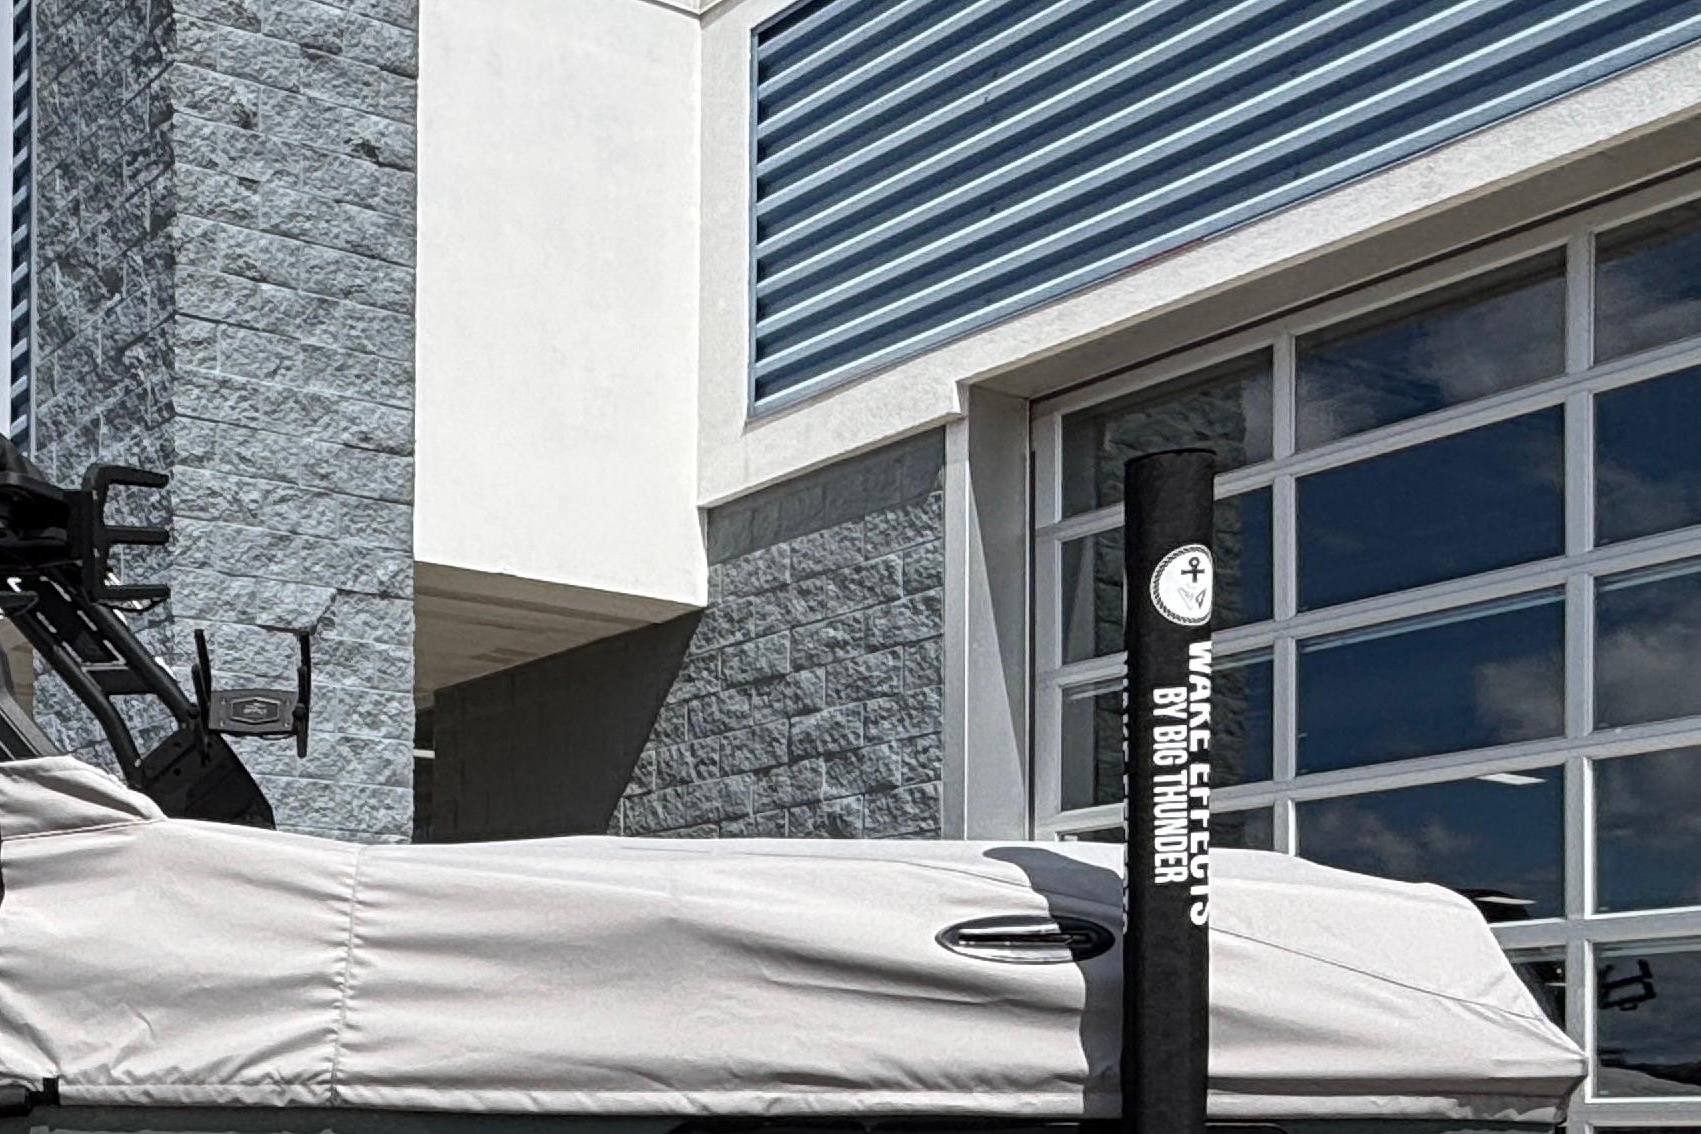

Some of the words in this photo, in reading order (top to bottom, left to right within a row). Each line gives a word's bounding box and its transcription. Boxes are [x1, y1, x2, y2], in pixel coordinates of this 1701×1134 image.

[1152, 686, 1188, 719] BY
[1152, 724, 1188, 766] BIG
[1152, 769, 1189, 884] THUNDER
